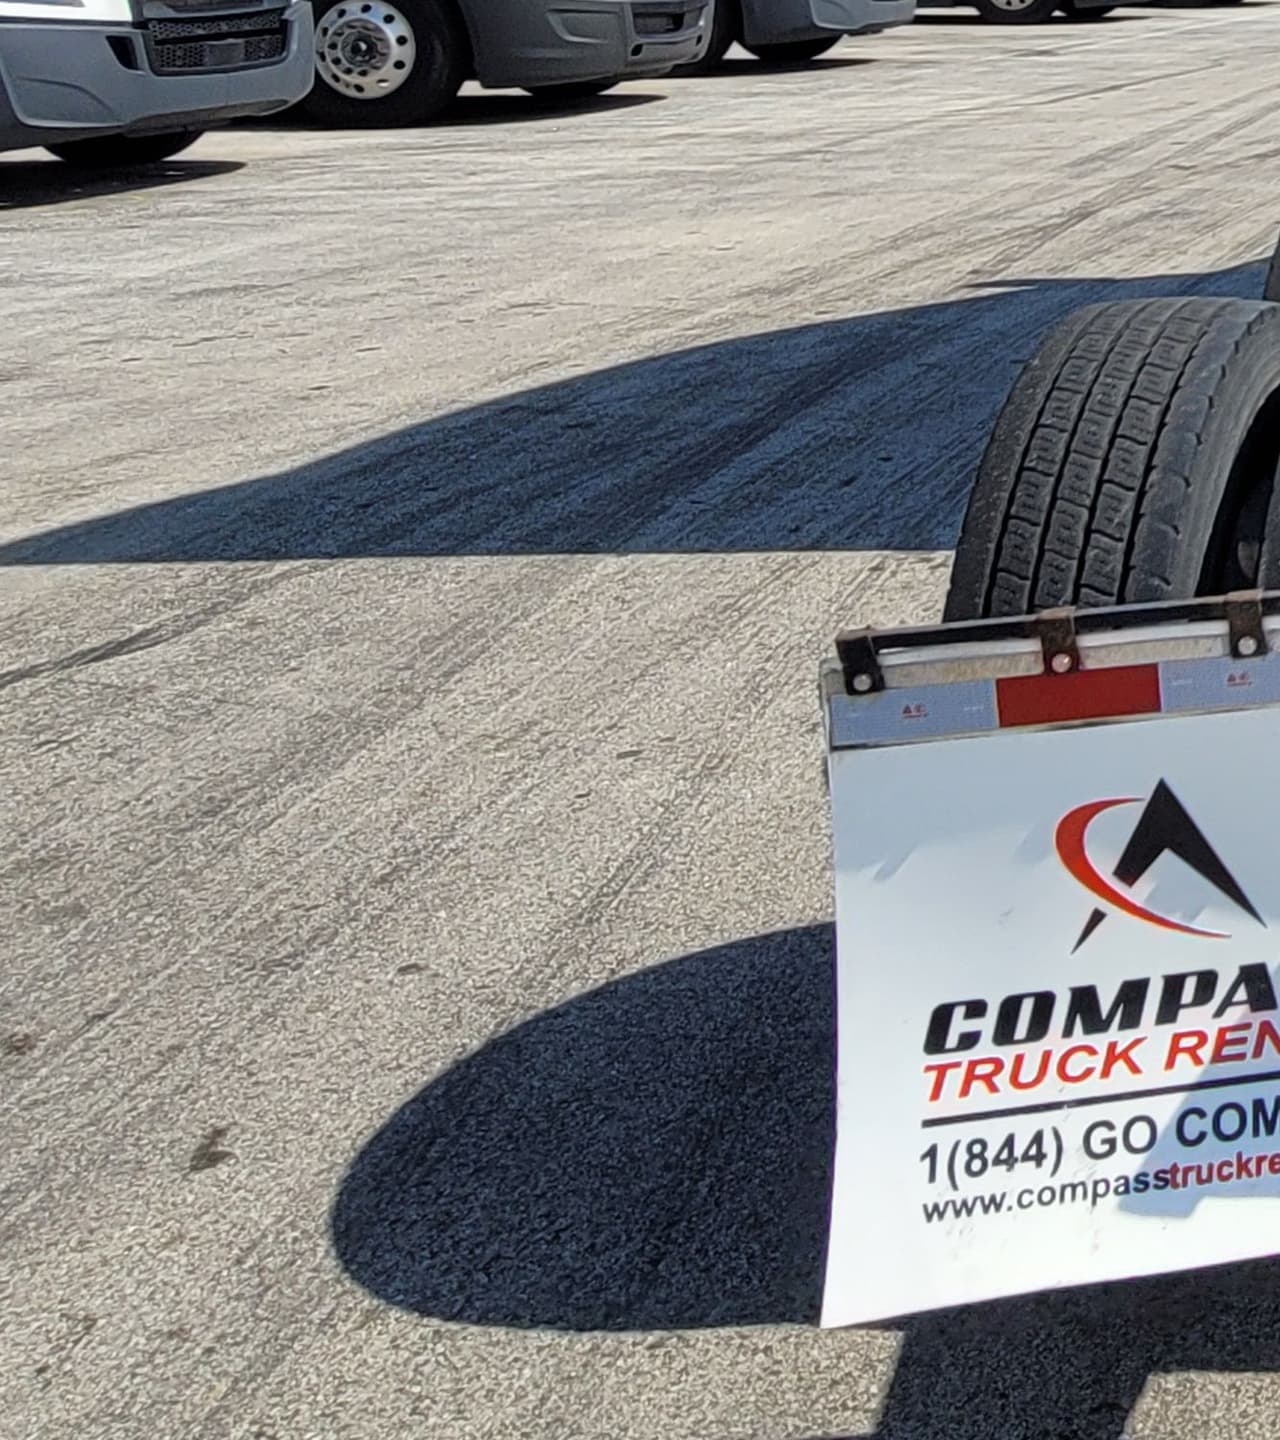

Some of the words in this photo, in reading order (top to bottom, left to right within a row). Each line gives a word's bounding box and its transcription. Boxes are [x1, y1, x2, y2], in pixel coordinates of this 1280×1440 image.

[923, 1037, 1148, 1102] TRUCK
[920, 1126, 1064, 1191] 1(844)
[1082, 1115, 1158, 1160] GO
